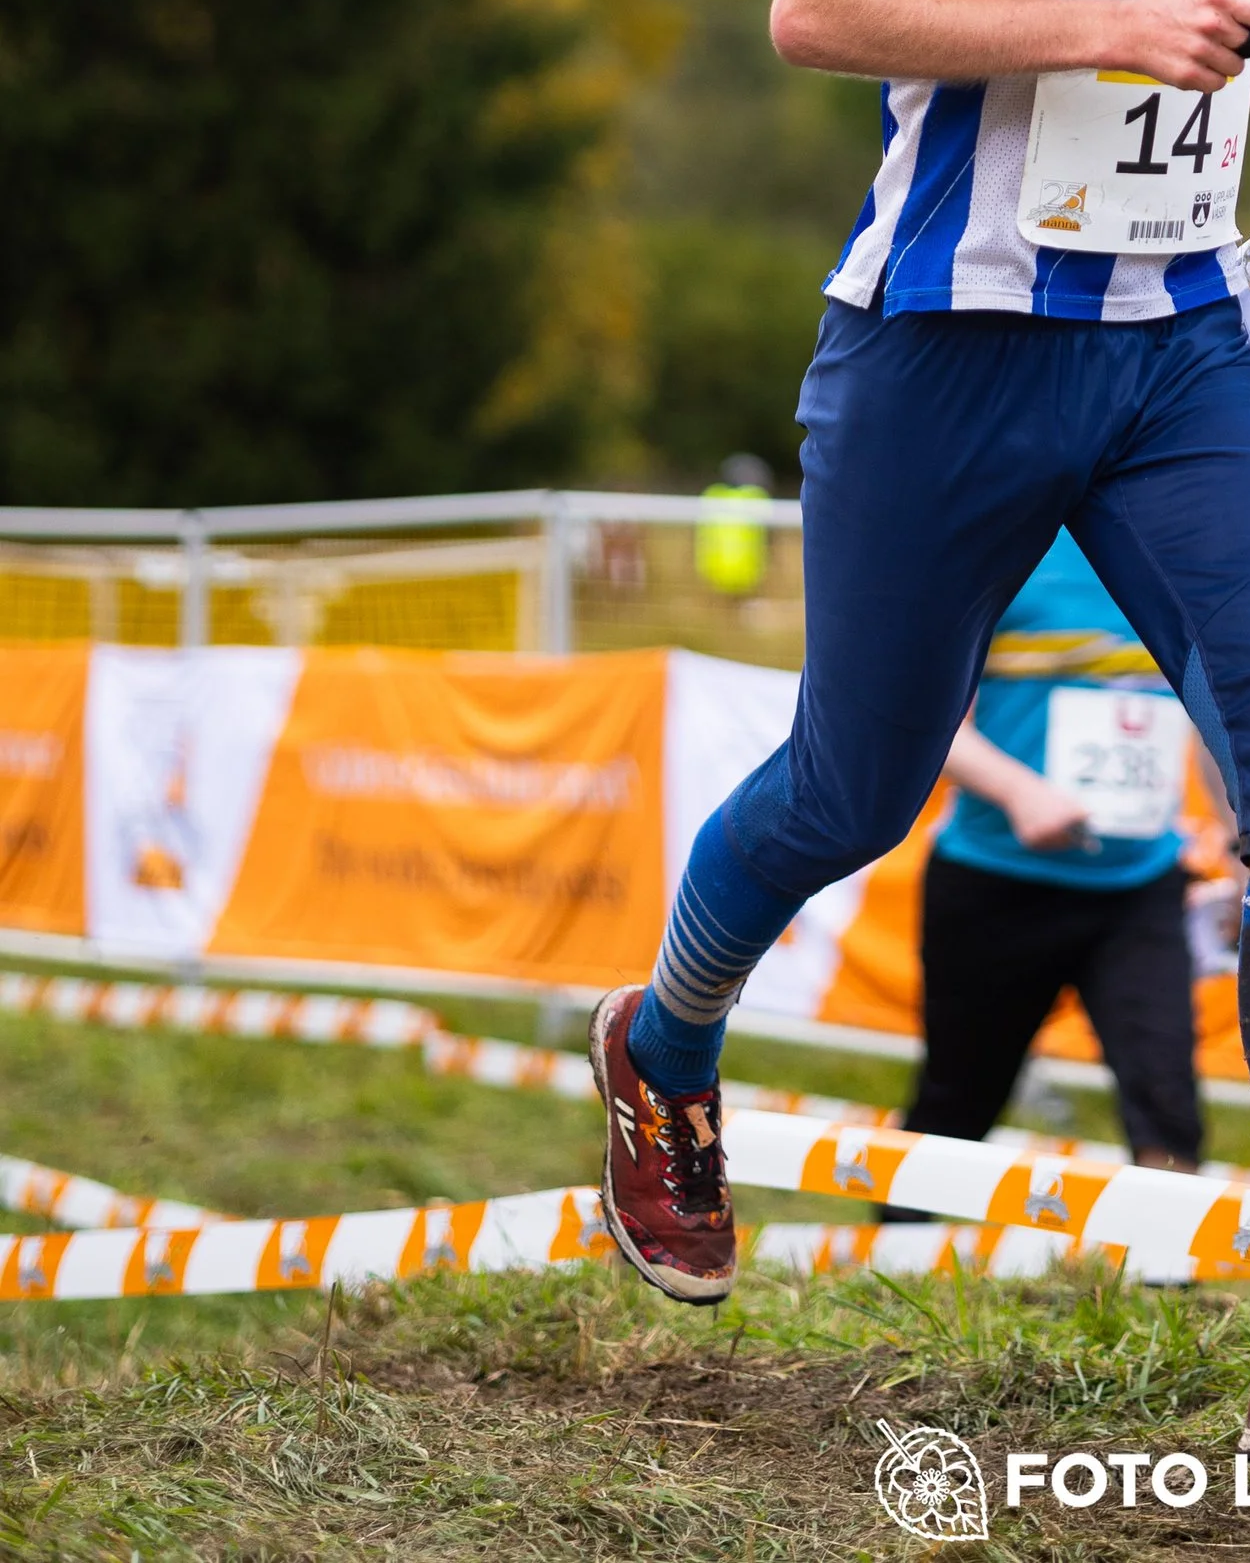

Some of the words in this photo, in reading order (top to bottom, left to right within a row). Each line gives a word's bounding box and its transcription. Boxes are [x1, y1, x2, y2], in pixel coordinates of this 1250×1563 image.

[1115, 91, 1213, 175] 14
[1221, 135, 1239, 168] 24
[1039, 217, 1080, 231] manna
